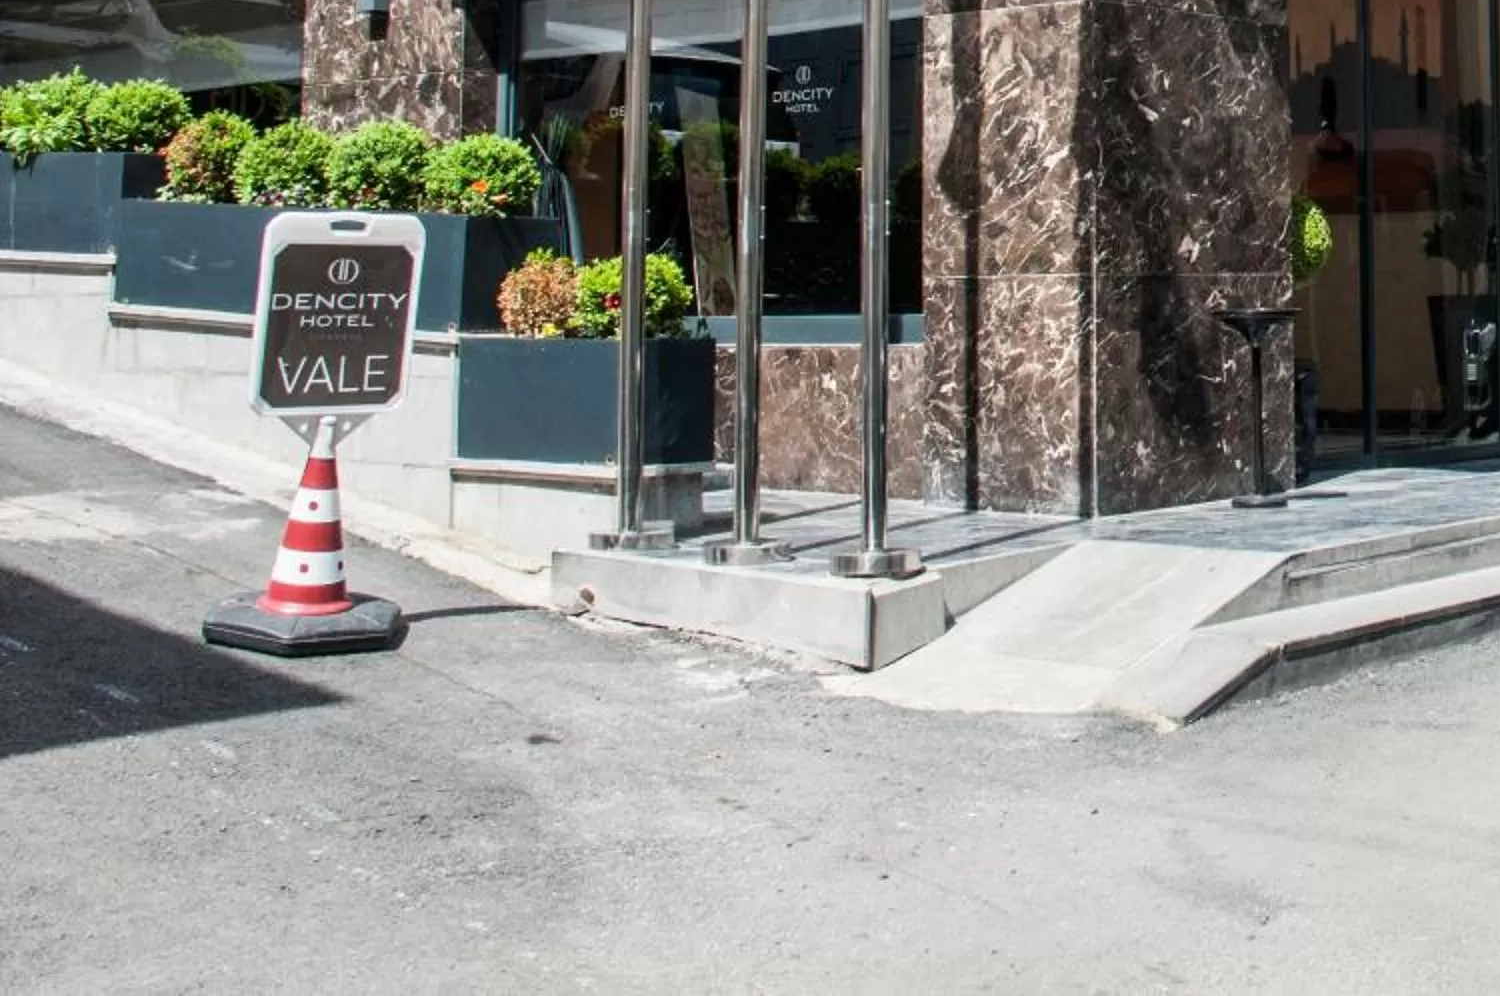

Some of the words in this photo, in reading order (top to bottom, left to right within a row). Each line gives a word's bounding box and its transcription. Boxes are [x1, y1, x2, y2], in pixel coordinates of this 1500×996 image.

[772, 87, 833, 105] DENCITY
[609, 101, 665, 118] DETY
[785, 105, 819, 114] HOTEL
[271, 292, 408, 311] DENCITY
[299, 314, 375, 328] HOTEL
[277, 355, 390, 394] VALE
